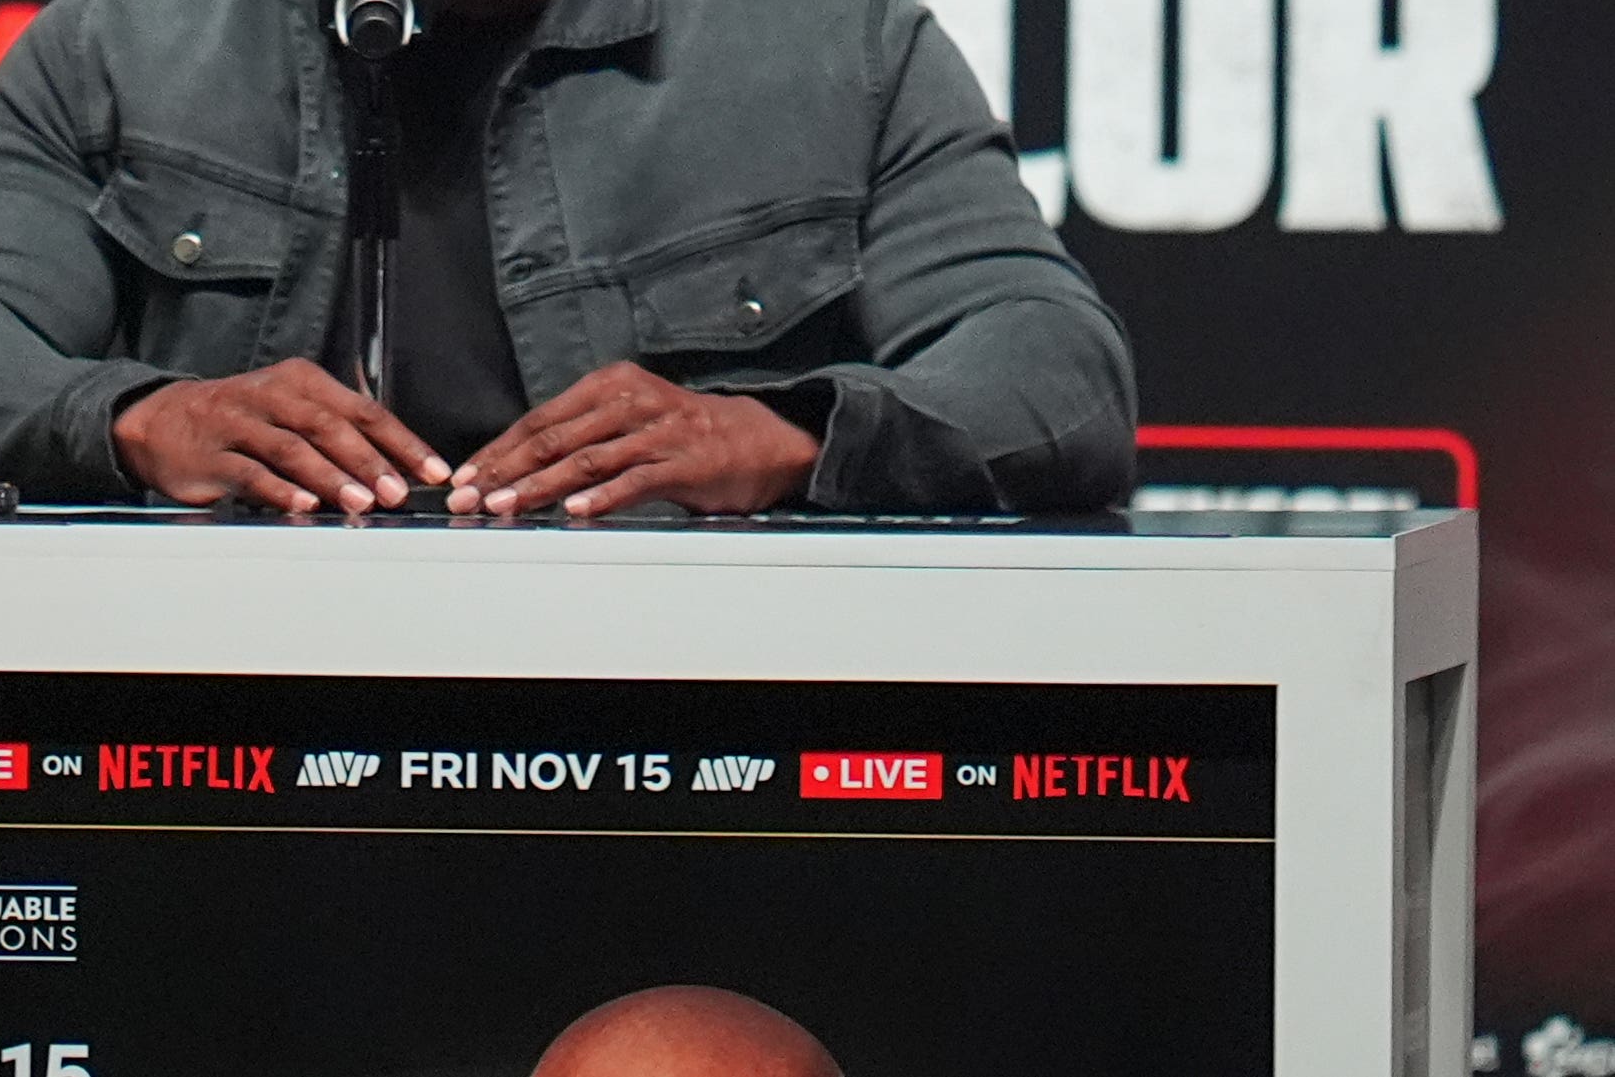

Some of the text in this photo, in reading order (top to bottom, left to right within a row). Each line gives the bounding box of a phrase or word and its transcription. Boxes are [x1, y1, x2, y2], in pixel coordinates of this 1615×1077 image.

[42, 754, 82, 776] ON
[98, 744, 275, 794] NETFLIX
[400, 751, 478, 790] FRI
[492, 752, 602, 791] NOV
[616, 754, 671, 792] 15
[841, 757, 927, 790] LIVE
[956, 764, 997, 786] ON
[1013, 754, 1190, 803] NETFLIX
[0, 1041, 92, 1077] 15
